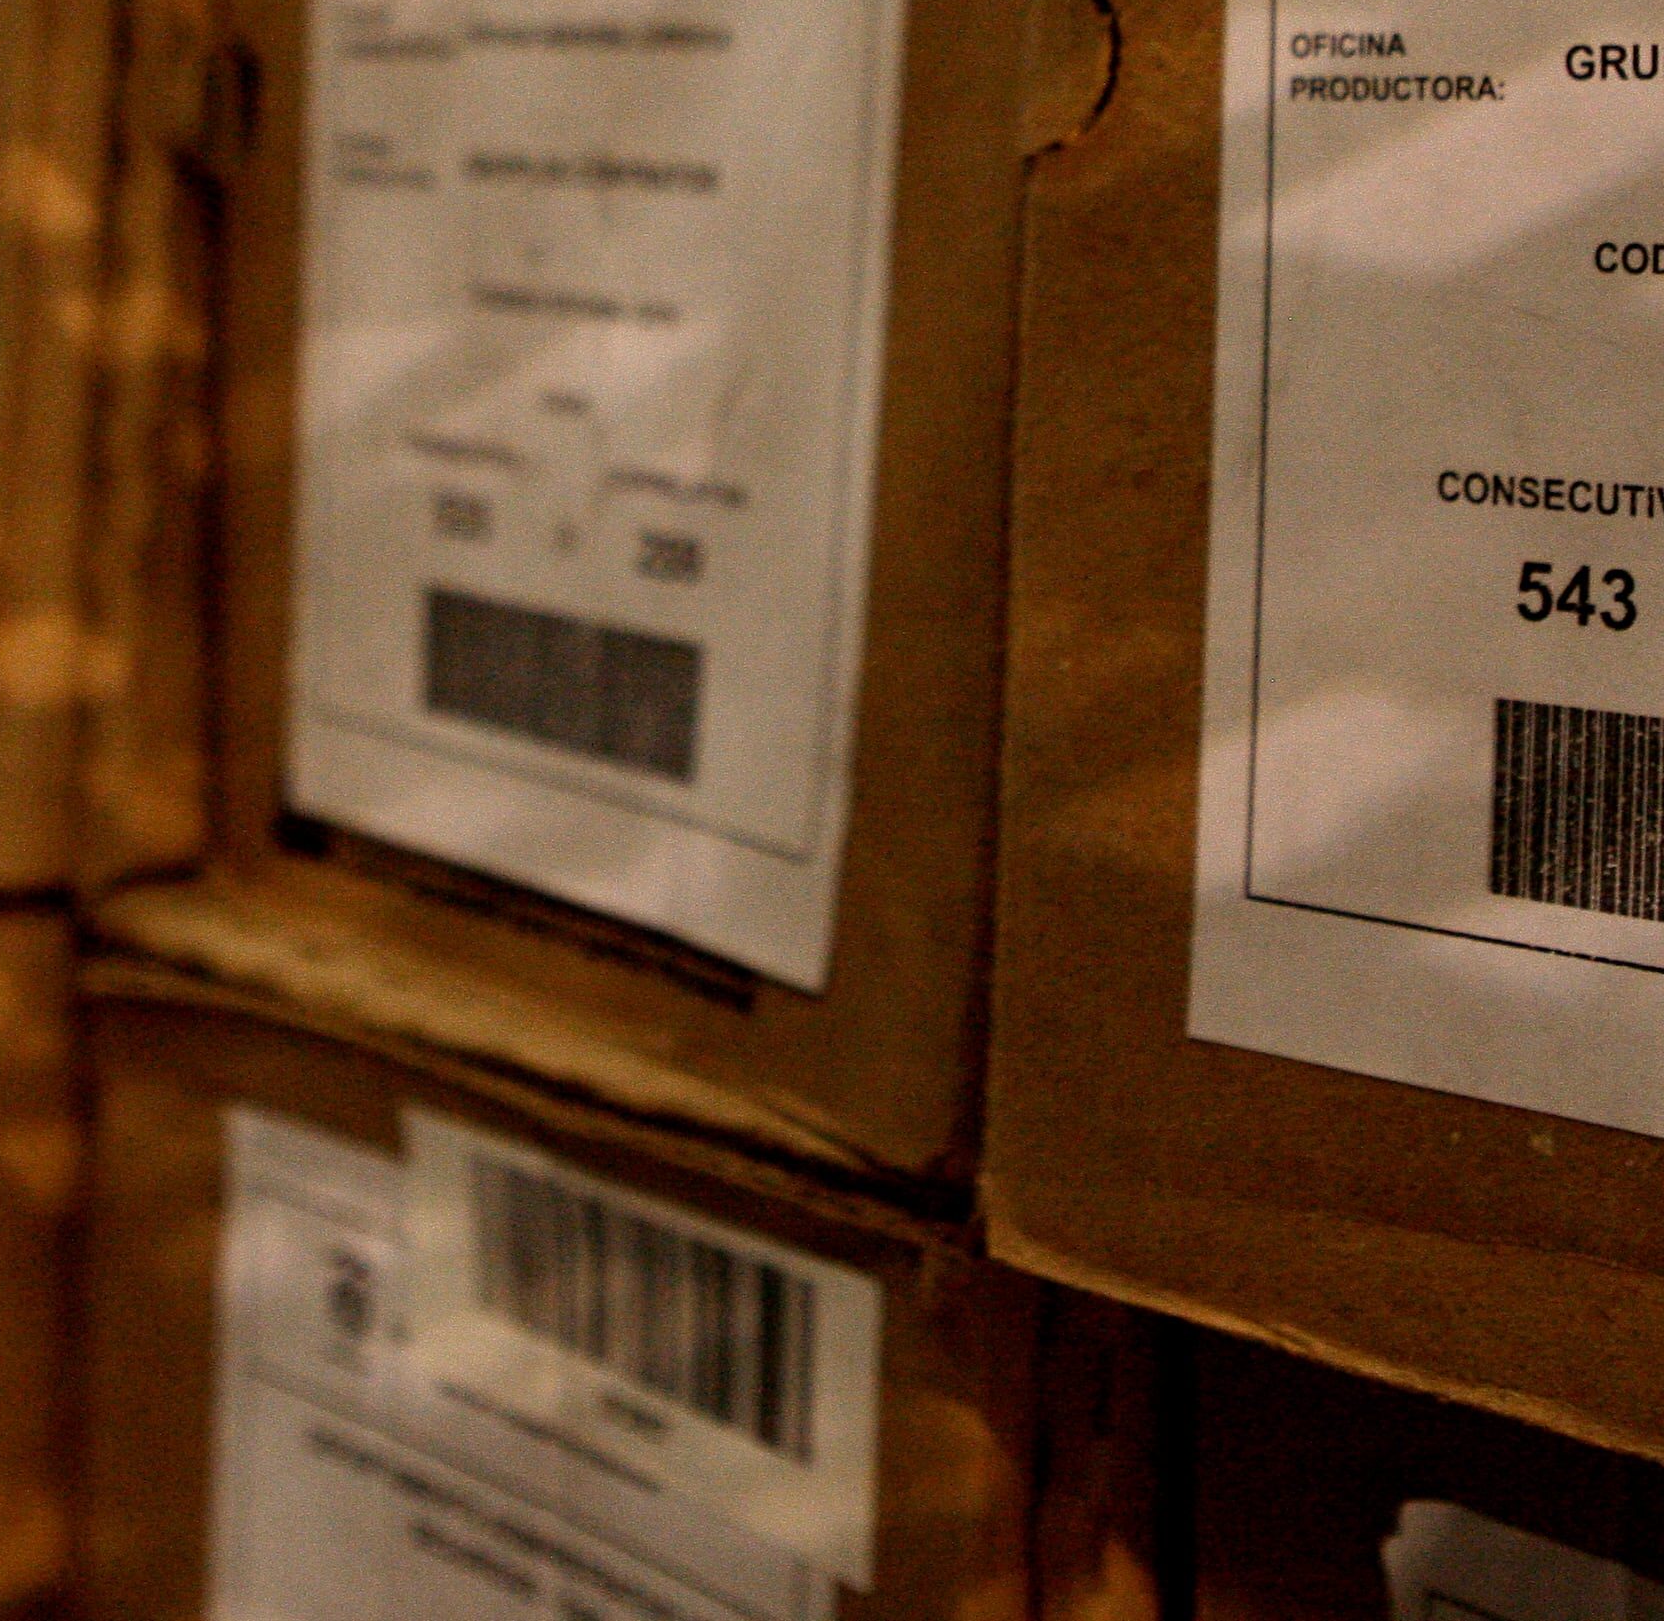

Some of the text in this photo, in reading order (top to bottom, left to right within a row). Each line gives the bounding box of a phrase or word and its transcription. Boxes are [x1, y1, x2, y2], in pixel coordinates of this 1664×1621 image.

[1293, 32, 1407, 58] OFICINA
[1291, 74, 1504, 102] PRODUCTORA:
[1517, 561, 1638, 632] 543
